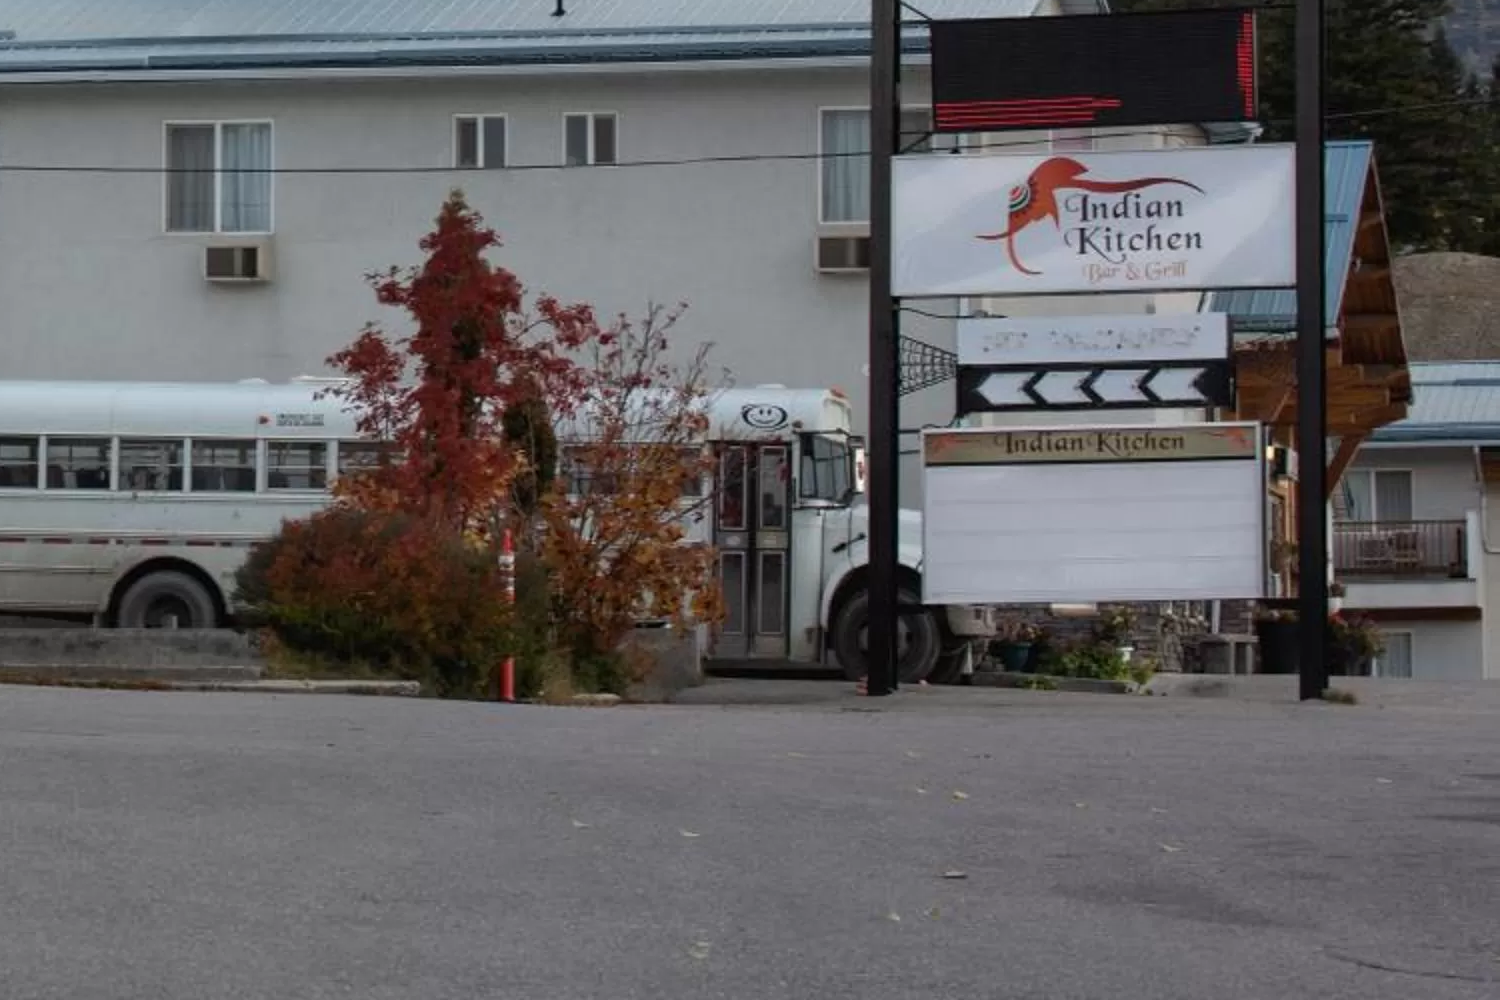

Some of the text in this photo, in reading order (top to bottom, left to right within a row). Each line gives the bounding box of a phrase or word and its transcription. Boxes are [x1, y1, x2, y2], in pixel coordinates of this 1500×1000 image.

[1064, 192, 1184, 222] Indian
[1063, 224, 1203, 264] Kitchen
[1082, 259, 1188, 283] Bar & Grill
[994, 431, 1185, 458] Indian Kitchen
